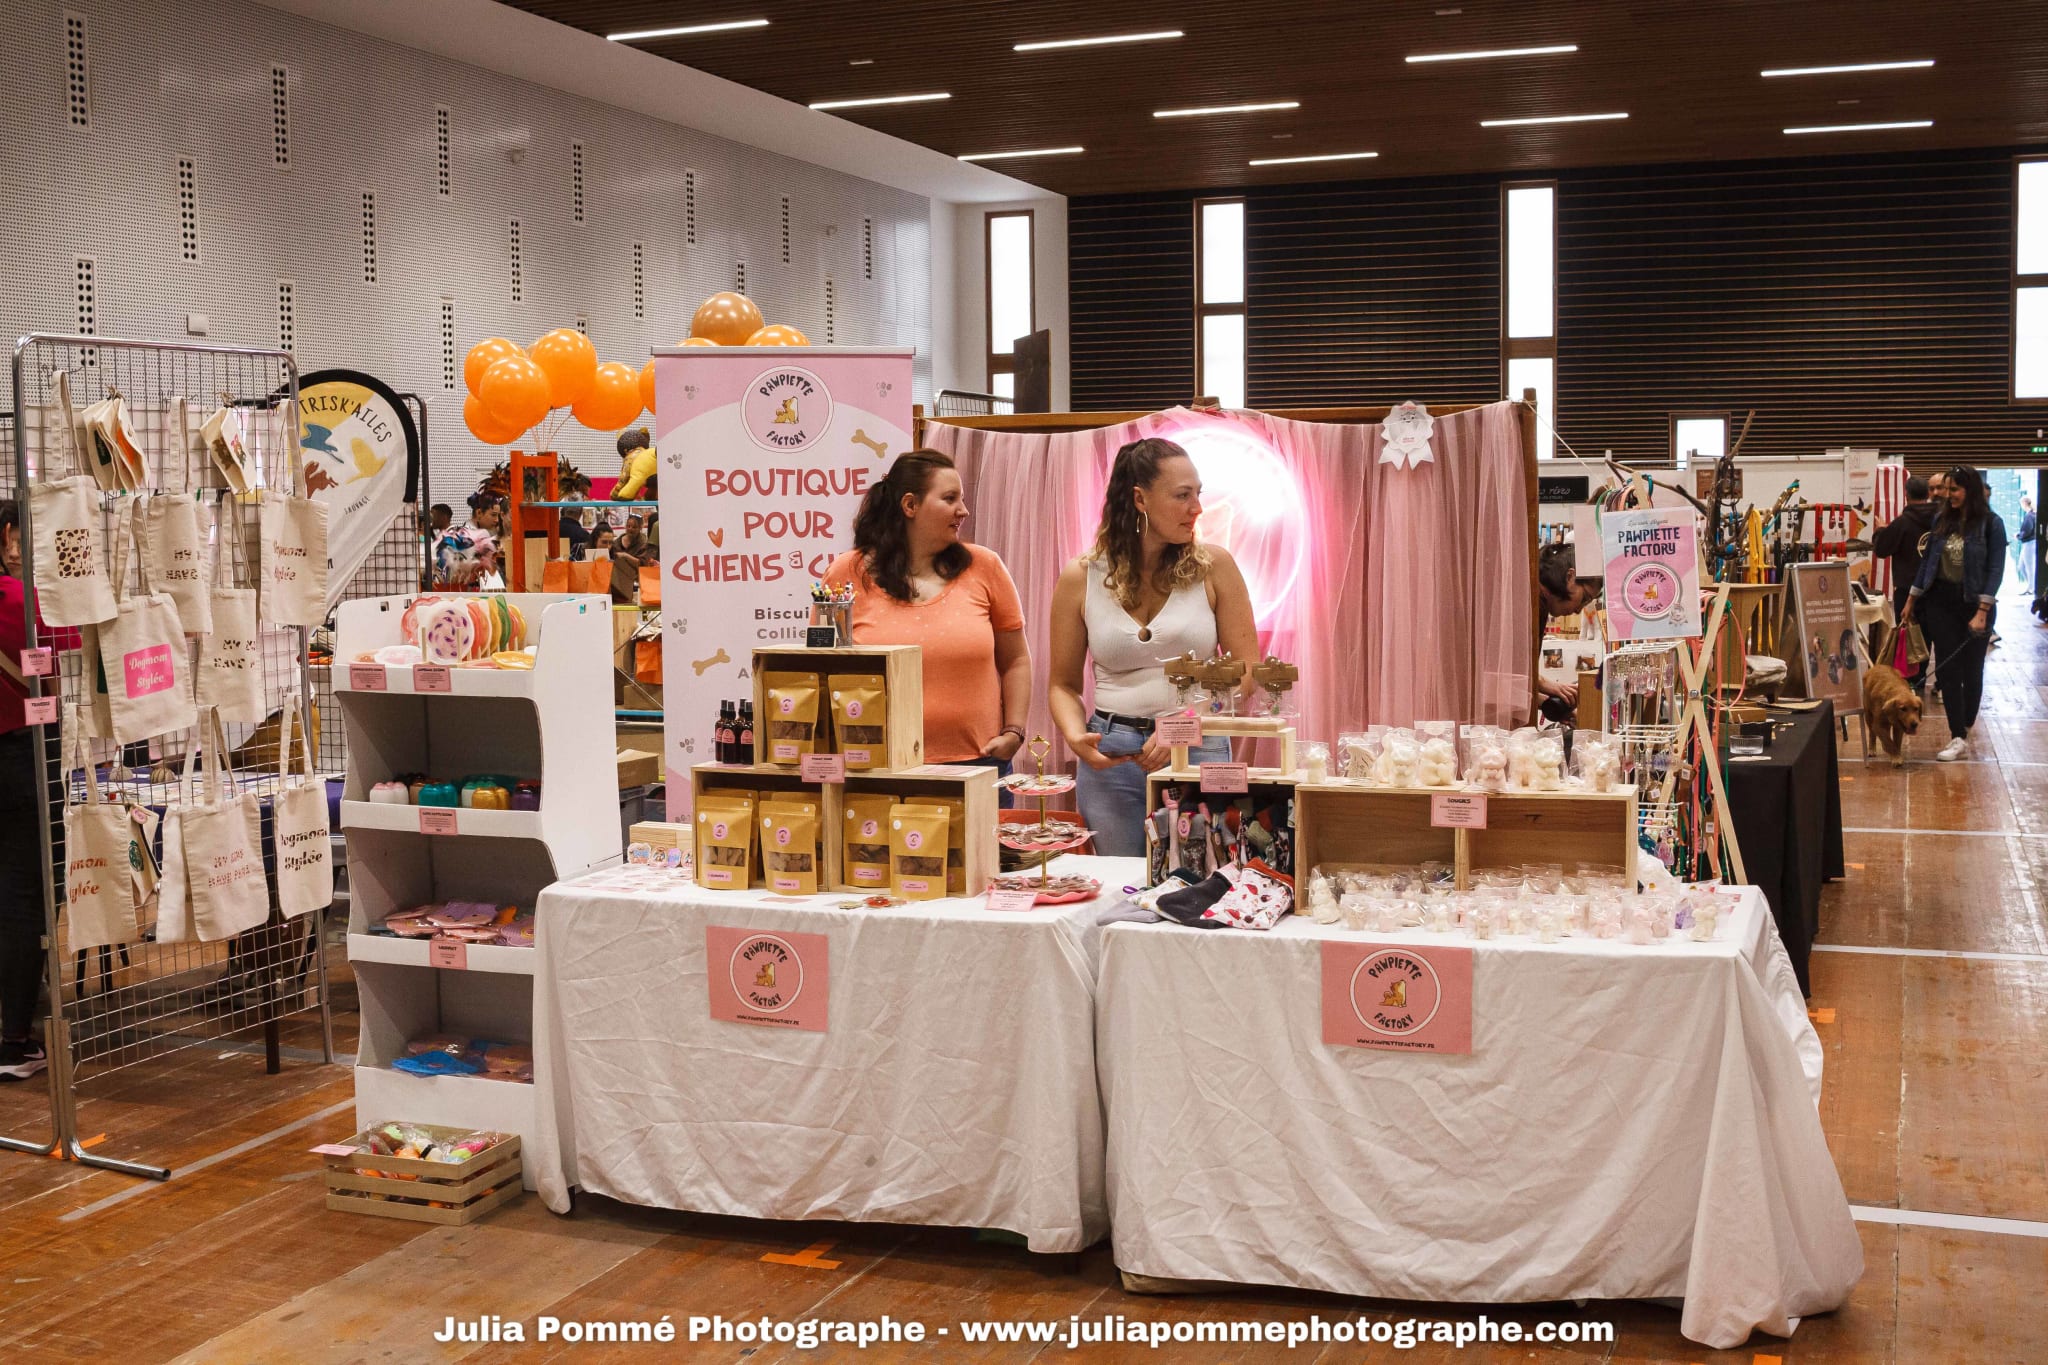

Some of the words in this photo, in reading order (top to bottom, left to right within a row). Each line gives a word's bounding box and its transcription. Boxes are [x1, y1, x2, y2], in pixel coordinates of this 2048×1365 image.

[759, 374, 814, 397] PAWPIETTE
[299, 395, 392, 443] TRISK'AILES
[766, 430, 806, 446] FACTORY
[705, 468, 871, 498] BOUTIQUE
[743, 511, 834, 539] POUR
[1617, 527, 1681, 544] PAWPIETTE
[1624, 542, 1676, 558] FACTORY
[672, 553, 785, 582] CHIENS
[1635, 570, 1667, 584] PAWPIETTE
[755, 607, 810, 620] Biscui
[1639, 602, 1664, 612] FACTORY
[129, 654, 168, 670] Dogmom
[136, 671, 164, 689] Stylée
[743, 941, 788, 963] PAWPIETTE
[1368, 956, 1422, 981] PAWPIETTE
[749, 991, 782, 1007] FACTORY
[1374, 1012, 1414, 1029] FACTORY
